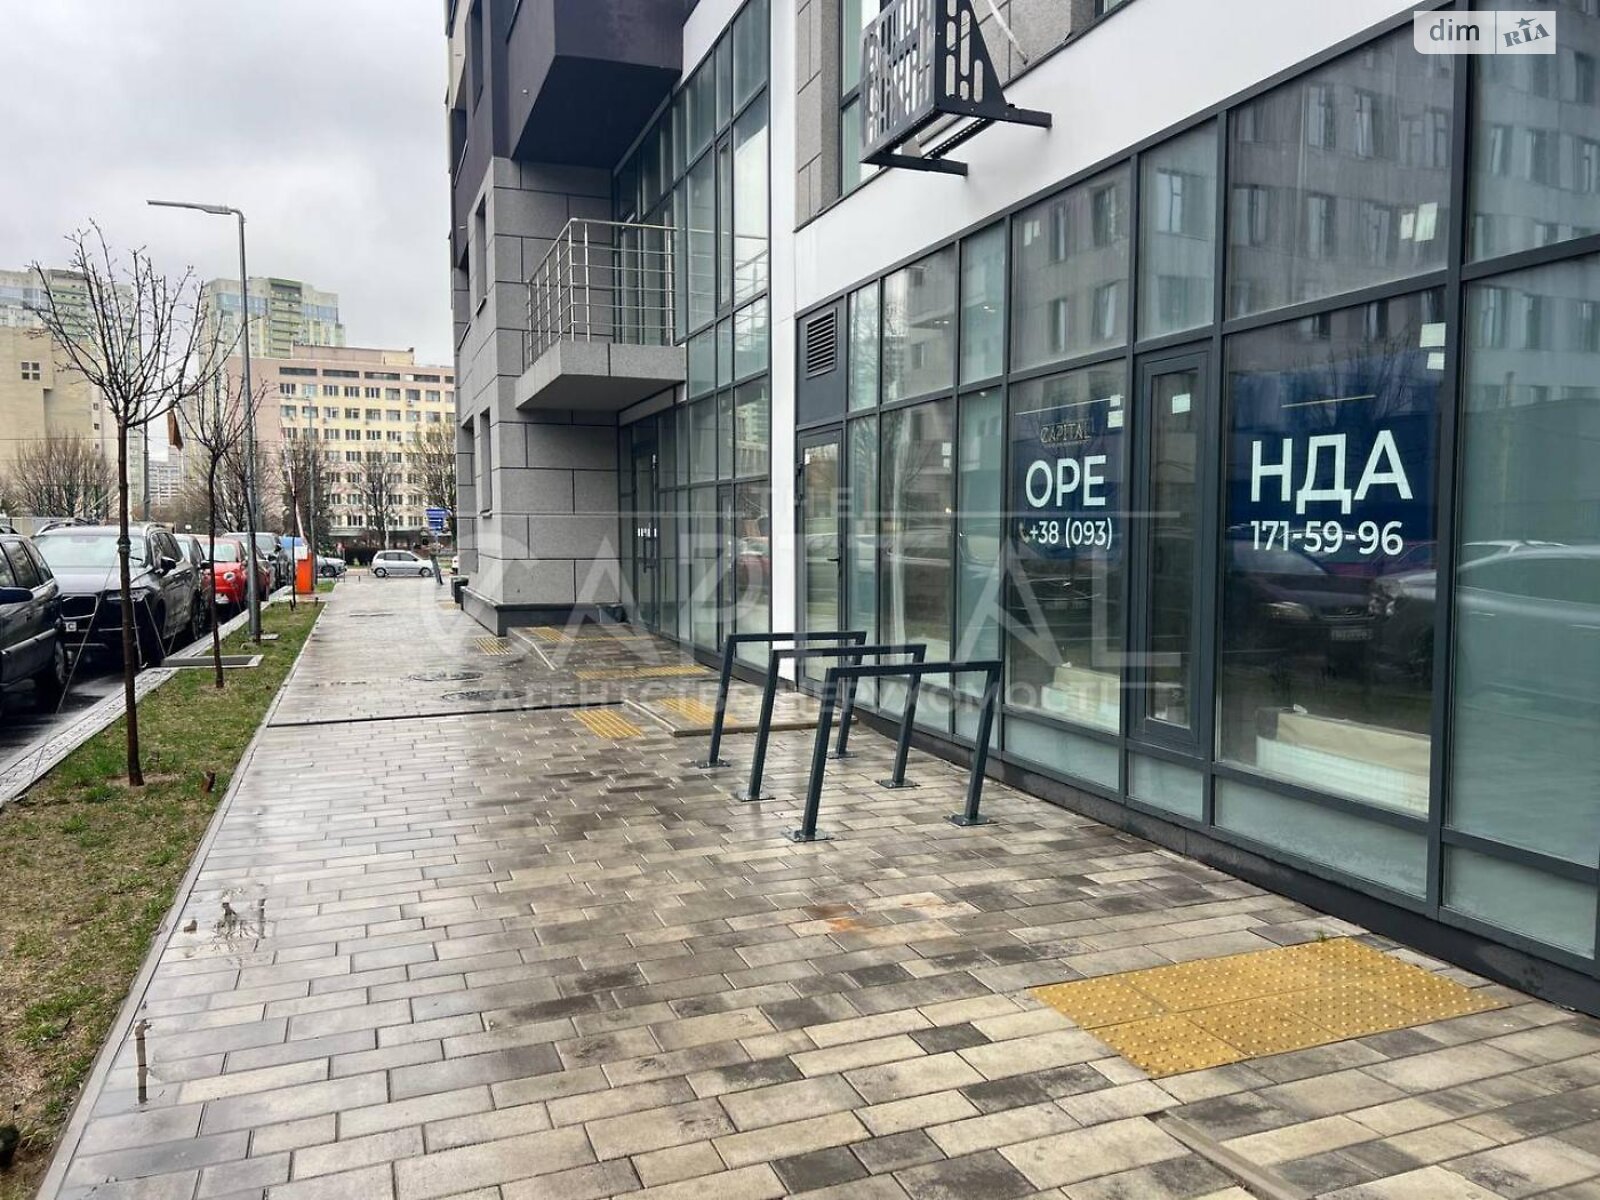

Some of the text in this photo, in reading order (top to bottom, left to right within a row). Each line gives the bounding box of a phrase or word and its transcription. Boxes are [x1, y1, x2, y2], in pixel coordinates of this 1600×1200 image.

[1041, 420, 1092, 443] CAPITAL
[1025, 429, 1414, 515] ОРЕ НДА
[1029, 518, 1405, 556] +38 (093) 171-59-96
